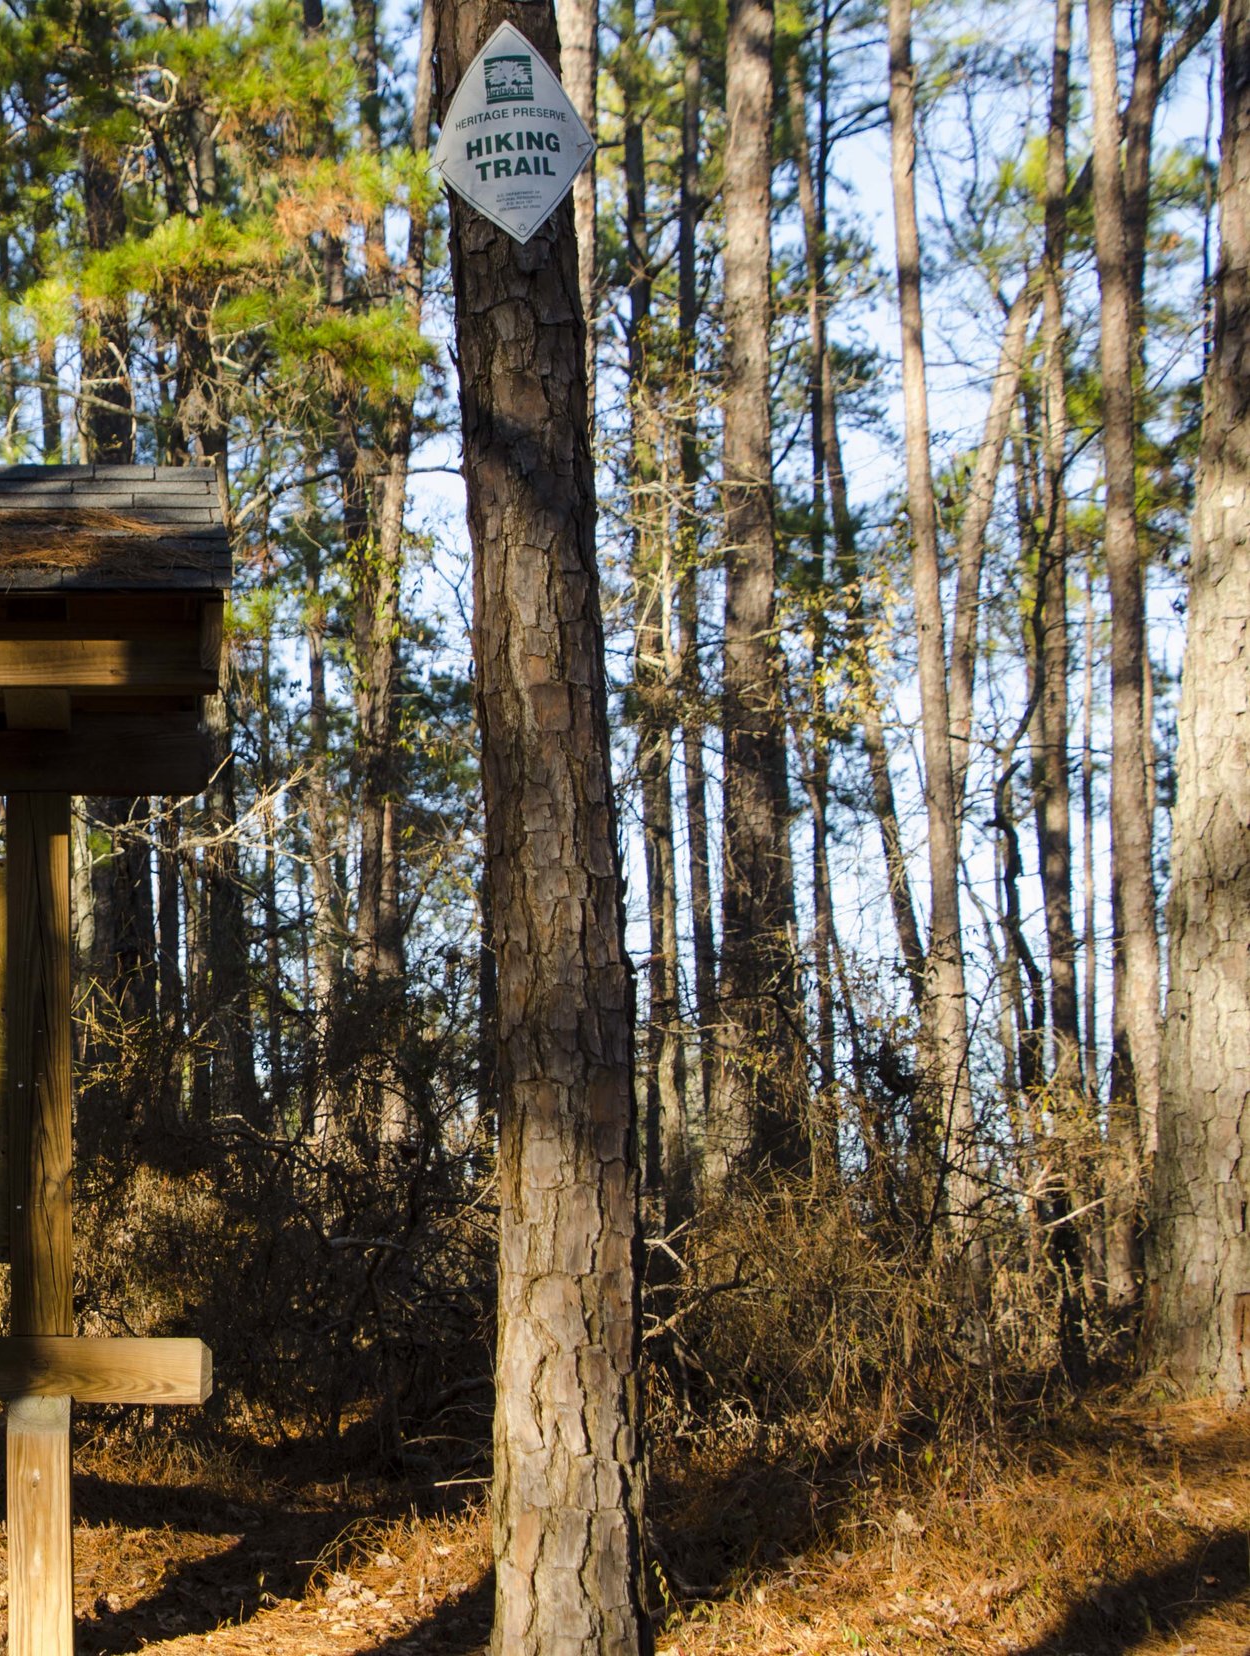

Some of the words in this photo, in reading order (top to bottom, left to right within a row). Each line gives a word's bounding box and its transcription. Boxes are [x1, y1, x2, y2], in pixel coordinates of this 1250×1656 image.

[486, 86, 515, 98] Heritage
[515, 85, 533, 96] Trust
[455, 109, 510, 131] HERITAGE
[512, 107, 567, 123] PRESERVE
[466, 131, 561, 160] HIKING
[475, 156, 556, 182] TRAIL
